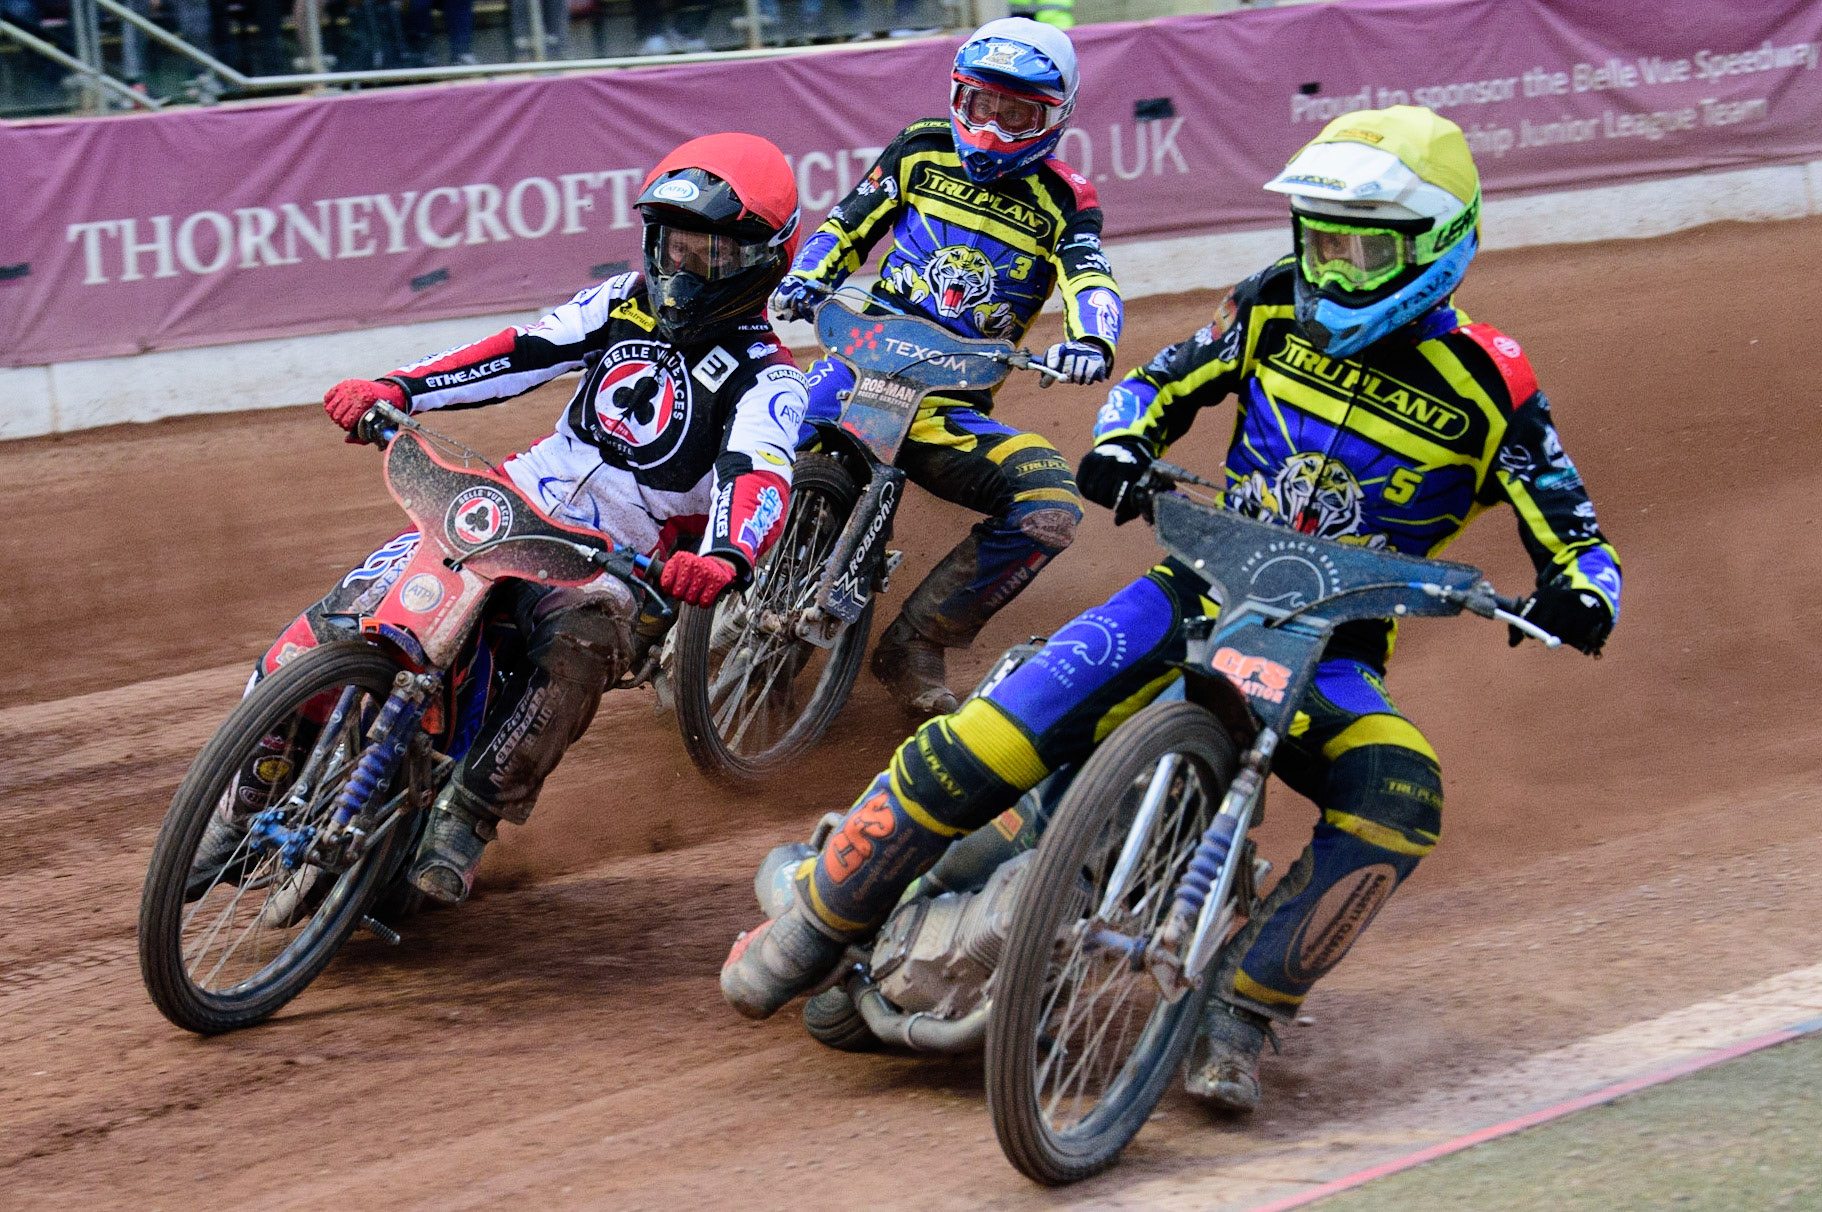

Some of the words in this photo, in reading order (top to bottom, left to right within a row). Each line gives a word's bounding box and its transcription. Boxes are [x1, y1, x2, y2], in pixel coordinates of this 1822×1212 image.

[1291, 85, 1371, 123] Proud
[1377, 86, 1410, 109] to
[1413, 76, 1519, 111] sponsor
[1522, 66, 1569, 97] the
[1573, 59, 1638, 93] Belle
[1638, 56, 1692, 84] Vue
[1694, 40, 1820, 84] Speedway
[1517, 114, 1600, 147] Junior
[1603, 108, 1698, 140] League
[1699, 98, 1767, 126] Team
[926, 173, 972, 200] TRU
[67, 167, 644, 285] THORNEYCROFT
[1009, 256, 1033, 281] 3
[885, 337, 967, 375] TEXOM
[1286, 341, 1342, 382] TRU
[604, 347, 650, 369] BELLE
[657, 348, 680, 377] VUE
[673, 379, 685, 421] ACES
[861, 377, 917, 403] ROB-MAN
[1383, 467, 1424, 505] 5
[458, 490, 484, 504] BELLE
[487, 490, 503, 504] VUE
[500, 505, 510, 526] ACES
[848, 501, 892, 575] ROBSON
[1269, 540, 1316, 554] BEACH
